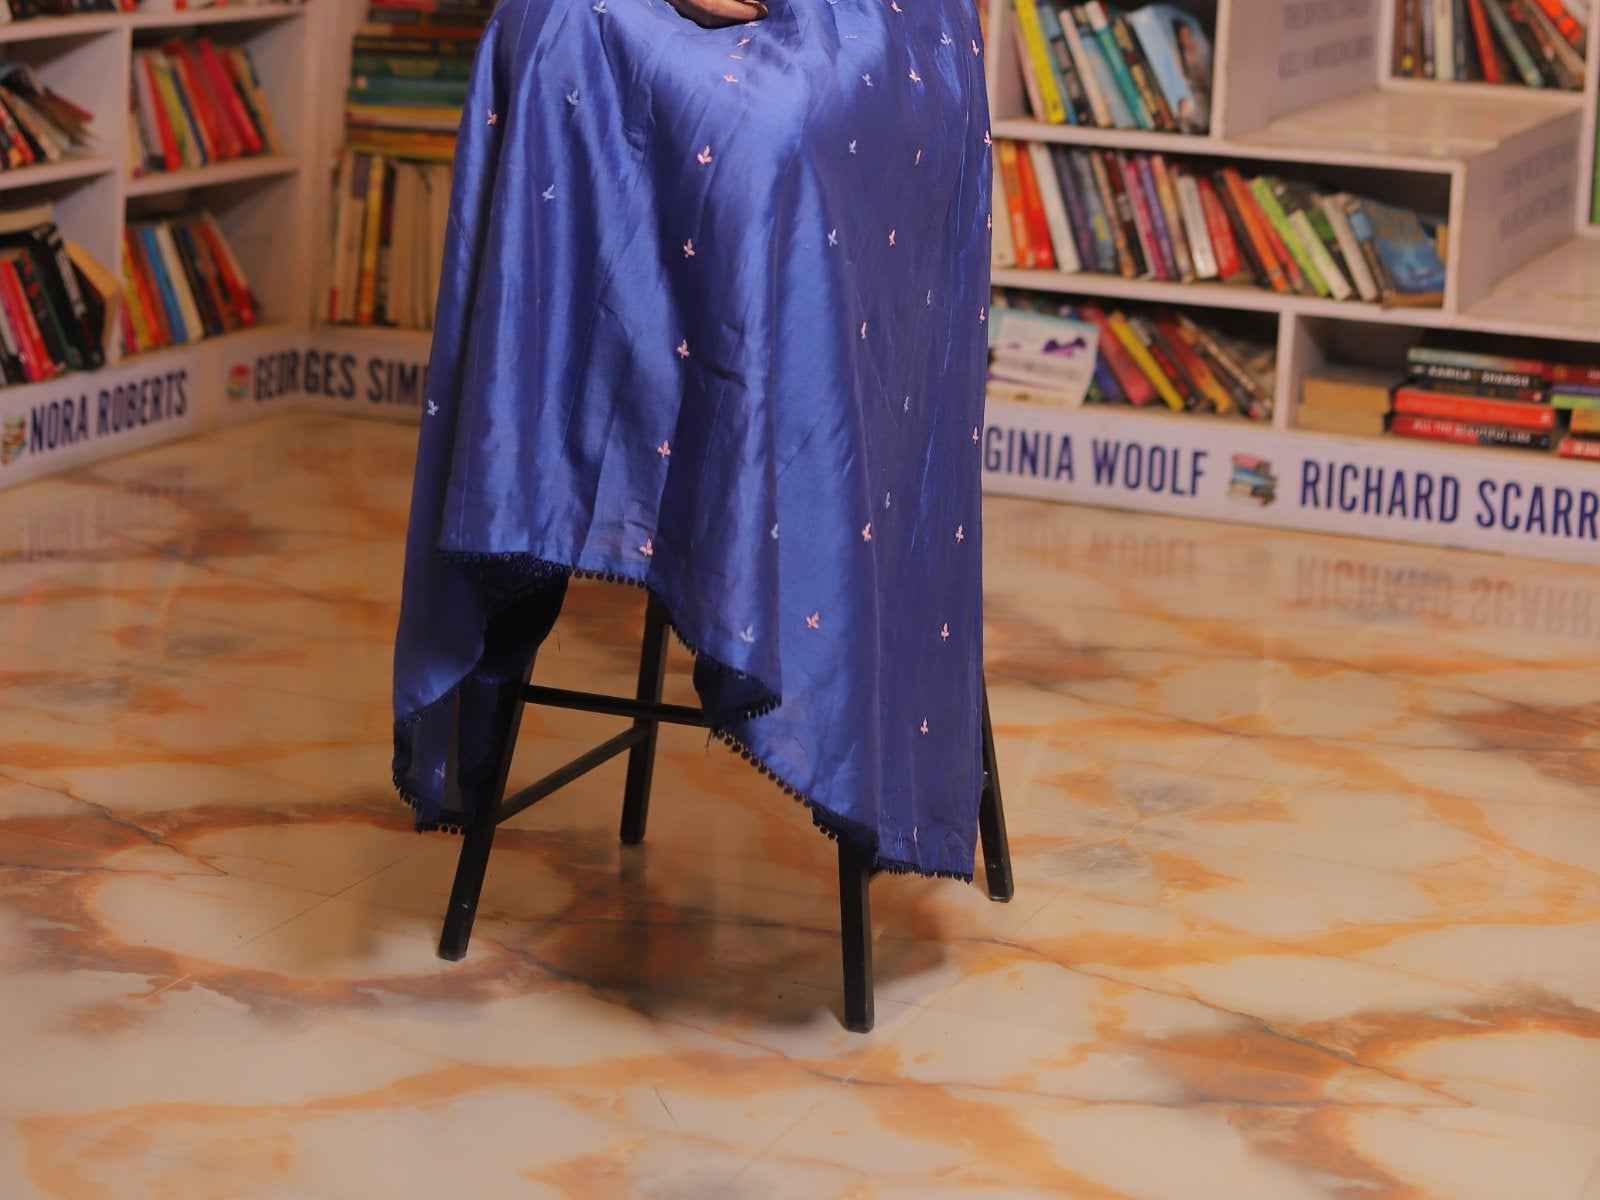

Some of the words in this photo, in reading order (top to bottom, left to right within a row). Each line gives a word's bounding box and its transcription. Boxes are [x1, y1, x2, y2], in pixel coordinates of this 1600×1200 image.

[30, 394, 88, 454] NORA
[97, 369, 187, 436] ROBERTS
[256, 349, 357, 402] GEORGES
[367, 357, 427, 405] SIM
[985, 425, 1074, 482] GINIA
[1091, 438, 1208, 497] WOOLF
[1299, 459, 1460, 523] RICHARD
[1475, 478, 1600, 541] SCARR
